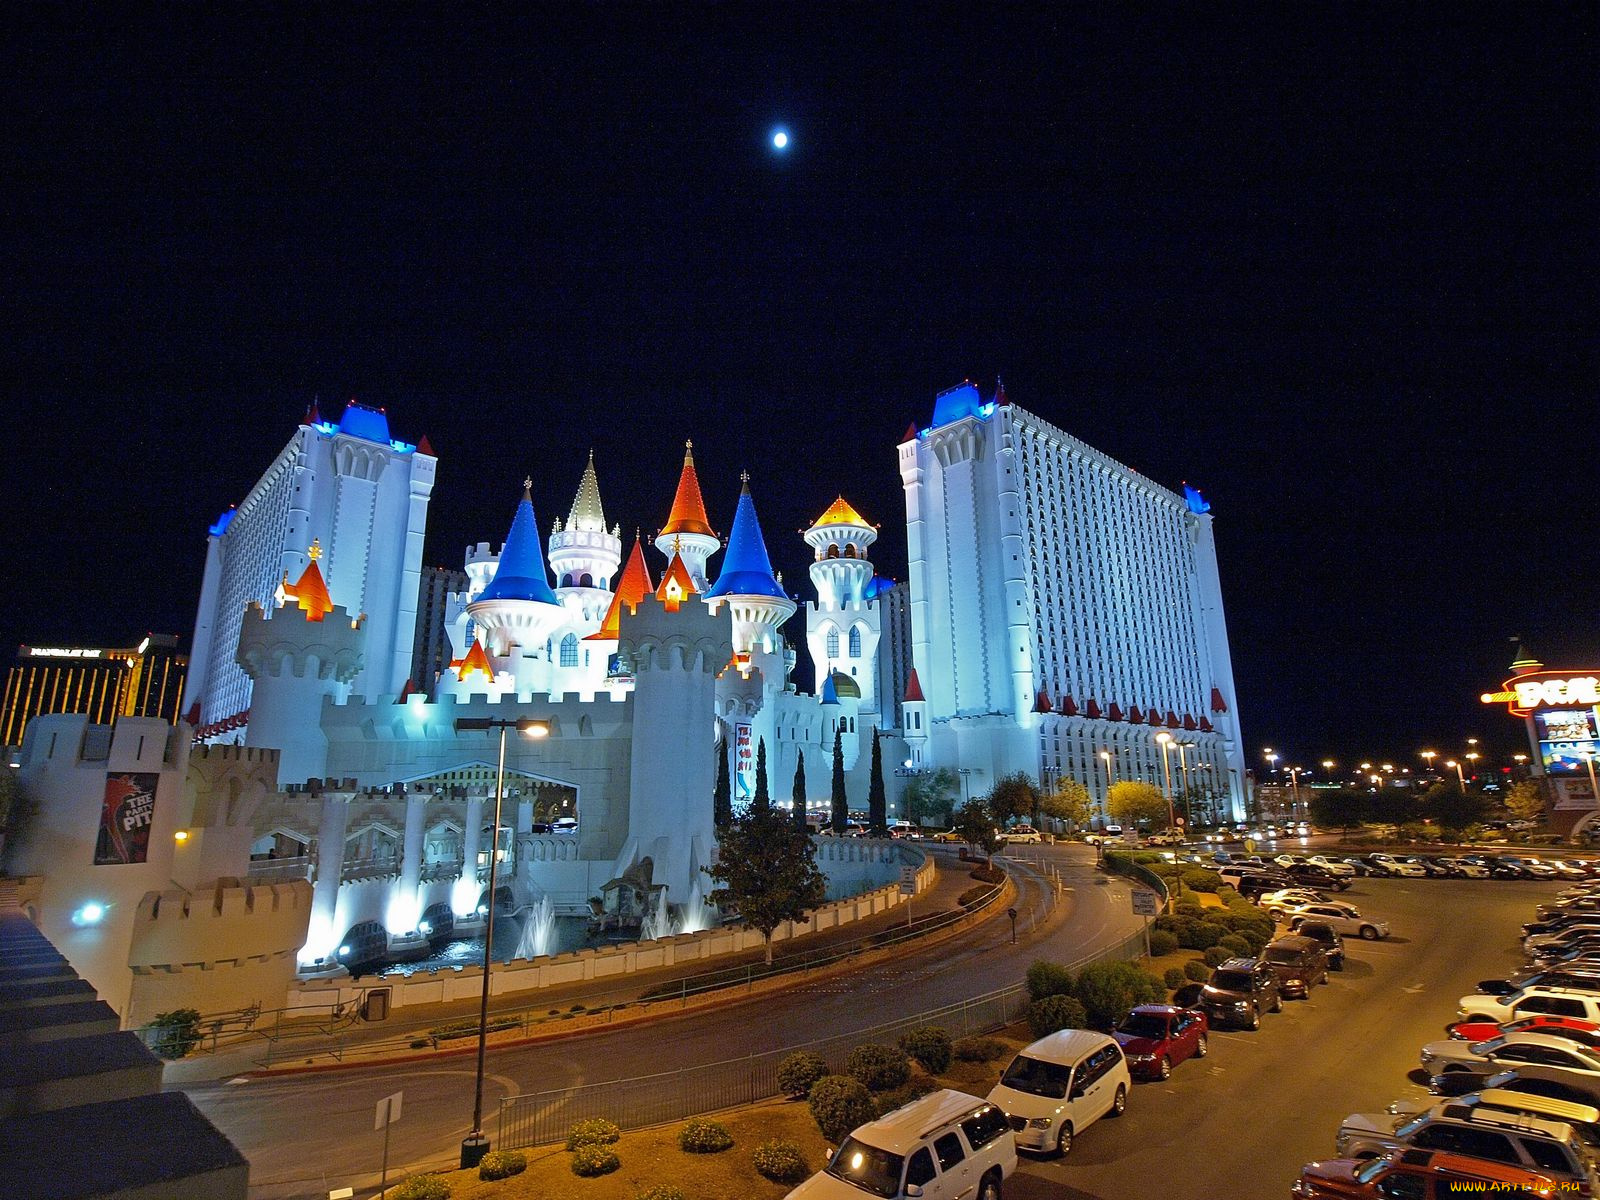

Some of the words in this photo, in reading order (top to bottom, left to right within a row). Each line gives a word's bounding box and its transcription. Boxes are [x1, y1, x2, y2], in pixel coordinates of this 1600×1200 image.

[126, 793, 153, 808] THE
[125, 804, 153, 817] PARTY
[124, 811, 152, 831] PIT
